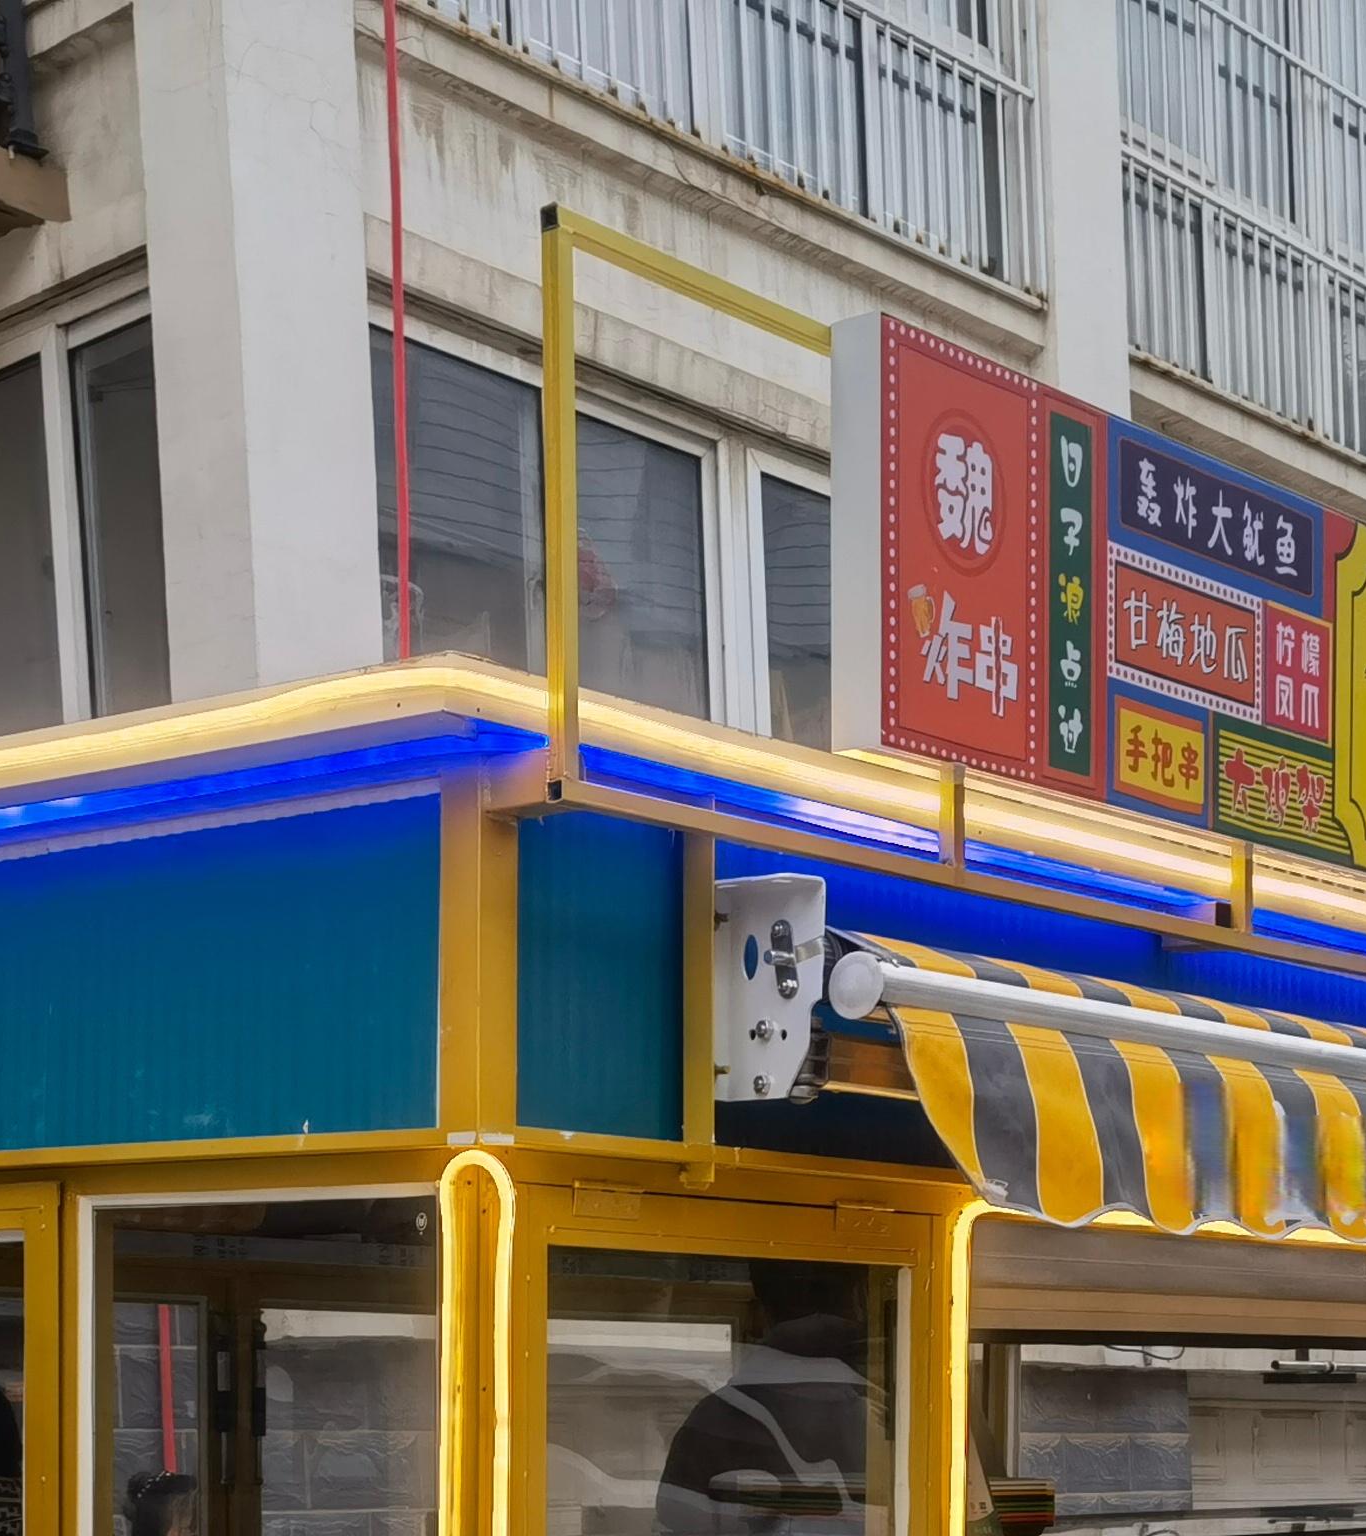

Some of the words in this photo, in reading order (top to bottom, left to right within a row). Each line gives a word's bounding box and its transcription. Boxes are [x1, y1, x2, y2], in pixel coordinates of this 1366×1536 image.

[935, 433, 993, 555] 魏
[1137, 458, 1298, 576] 轰炸大鱿鱼
[921, 590, 1019, 718] 炸串
[1123, 590, 1249, 683] 甘梅地瓜
[1126, 724, 1200, 790] 手把串
[1224, 747, 1326, 834] 大鸡架
